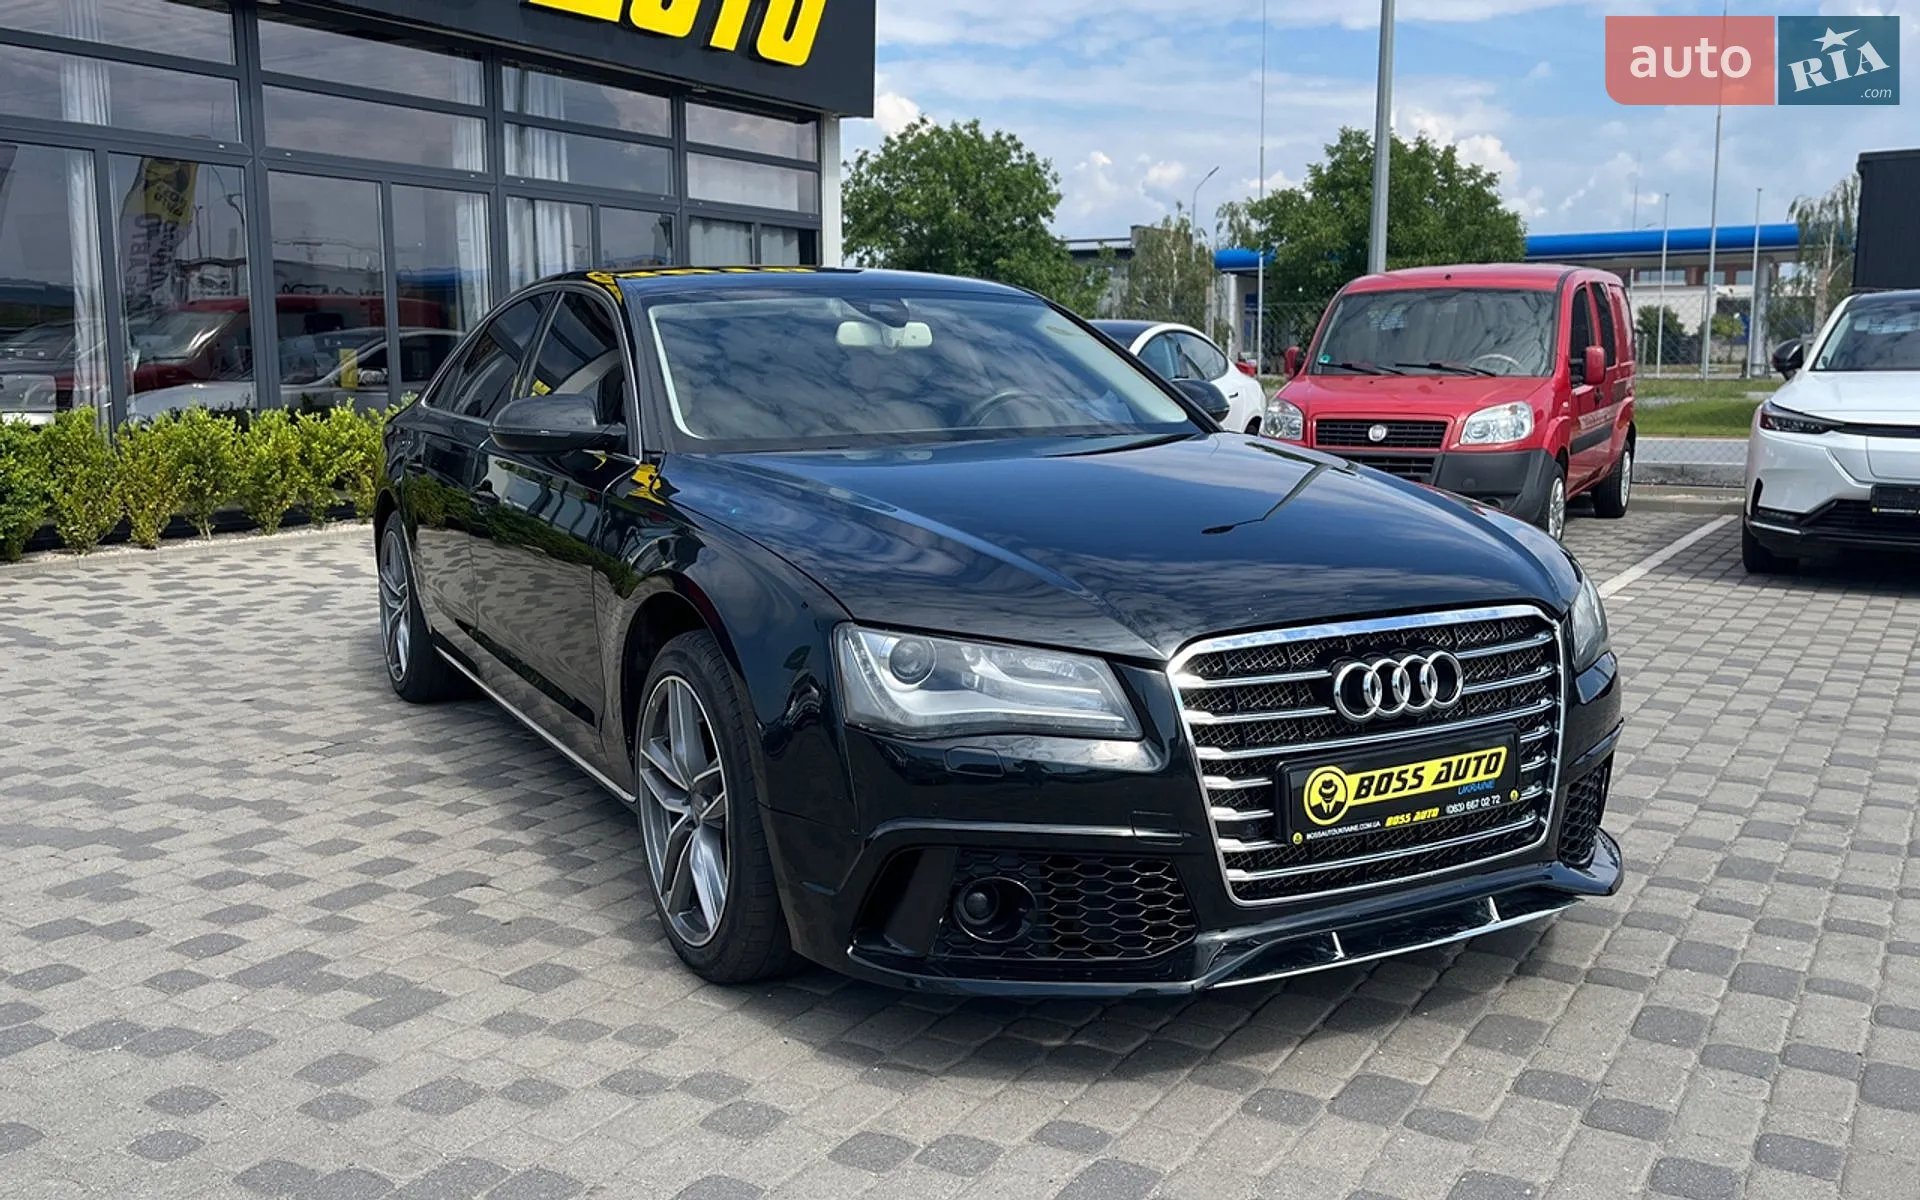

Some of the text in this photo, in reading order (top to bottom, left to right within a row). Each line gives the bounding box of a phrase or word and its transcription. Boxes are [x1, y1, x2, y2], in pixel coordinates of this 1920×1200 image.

[527, 0, 827, 67] TO
[1353, 751, 1503, 800] BOSS AUTO
[1384, 807, 1440, 828] BOSS AUTO
[1480, 796, 1491, 807] 02
[1491, 794, 1501, 805] 72
